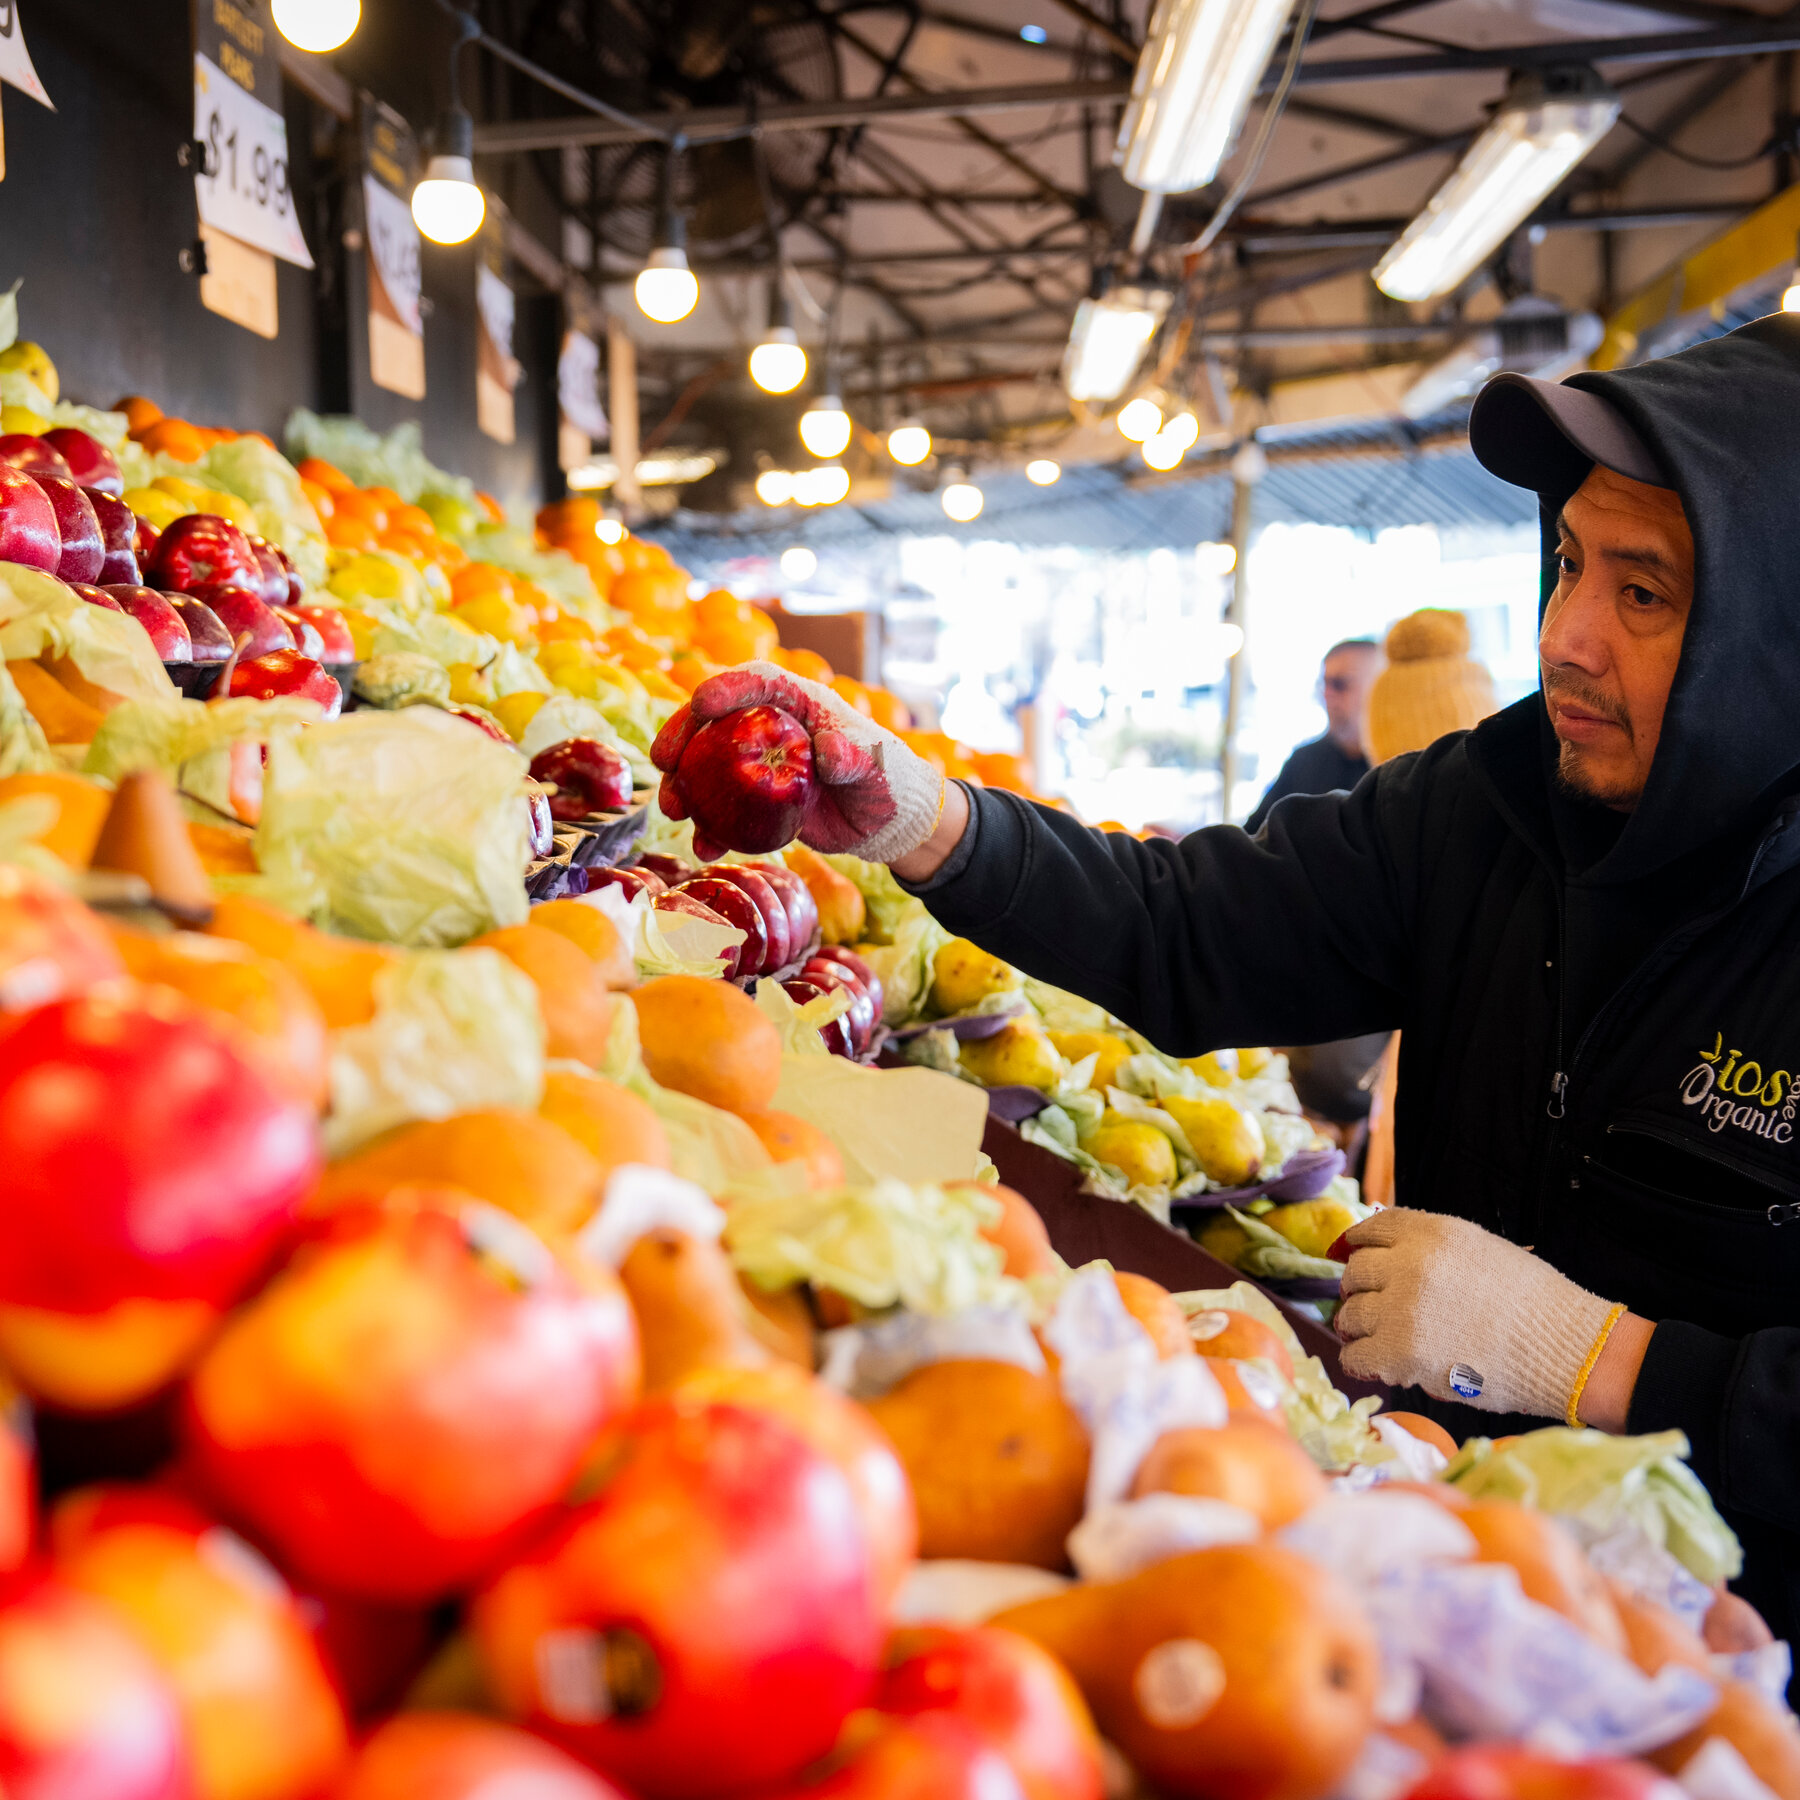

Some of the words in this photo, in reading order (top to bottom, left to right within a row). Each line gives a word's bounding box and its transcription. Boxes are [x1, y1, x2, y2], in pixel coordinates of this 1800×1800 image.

[205, 109, 290, 216] $1.99
[1679, 1062, 1794, 1144] Organic
[1459, 1386, 1474, 1395] 4044
